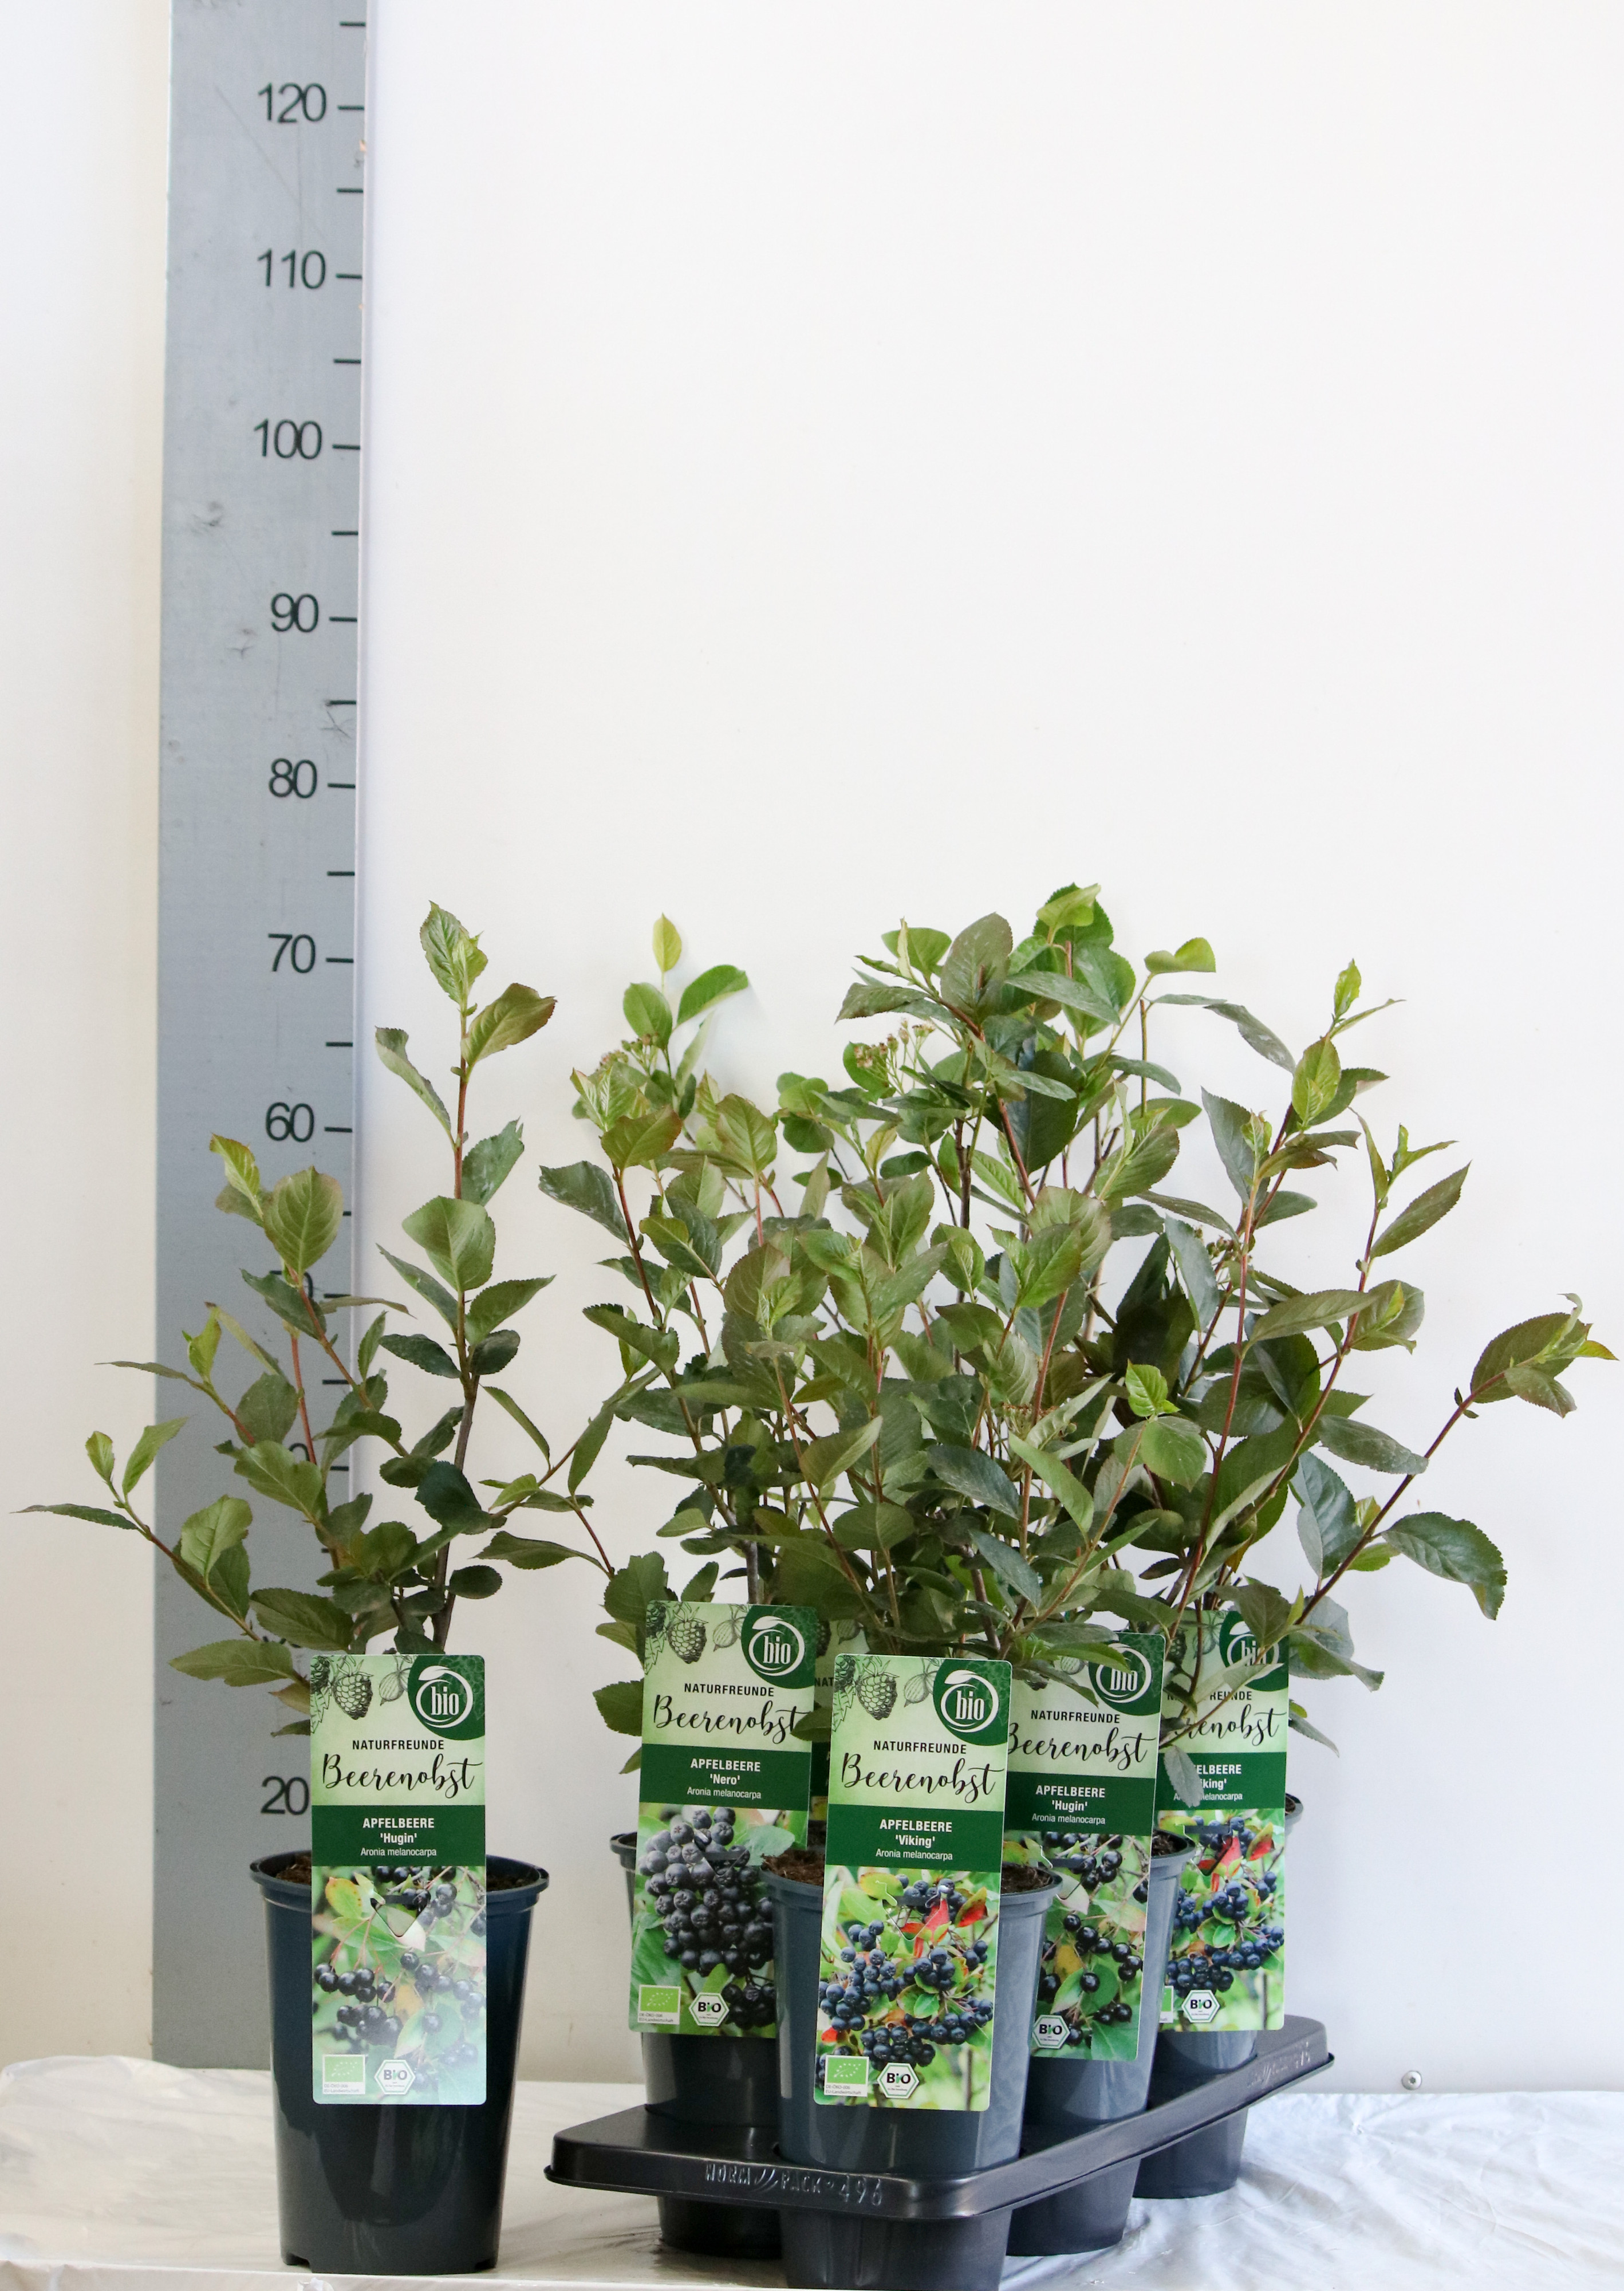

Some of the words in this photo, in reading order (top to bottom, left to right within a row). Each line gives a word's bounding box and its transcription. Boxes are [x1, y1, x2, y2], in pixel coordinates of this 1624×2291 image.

[258, 82, 327, 123] 120
[257, 249, 326, 289] 110
[254, 419, 322, 460] 100
[270, 593, 319, 633] 90
[269, 758, 317, 798] 80
[268, 934, 316, 973] 70
[265, 1102, 314, 1143] 60
[763, 1635, 791, 1665] bio
[684, 1683, 774, 1697] NATURFREUNDE
[431, 1687, 459, 1716] bio
[955, 1690, 986, 1721] bio
[653, 1694, 811, 1745] Beerenobst
[1031, 1710, 1120, 1724] NATURFREUNDE
[352, 1739, 444, 1750] NATURFREUNDE
[873, 1740, 967, 1754] NATURFREUNDE
[691, 1758, 761, 1772] APFELBEERE
[1196, 1764, 1242, 1774] ELBEERE
[322, 1753, 483, 1798] Beerenobst
[710, 1774, 740, 1786] 'Nero'
[842, 1752, 1004, 1804] Beerenobst
[260, 1776, 310, 1815] 20
[687, 1786, 711, 1797] Aronia
[713, 1788, 762, 1800] melanocarpa
[1035, 1785, 1105, 1798] APFELBEERE
[1051, 1800, 1088, 1813] 'Hugin'
[362, 1818, 435, 1829] APFELBEERE
[879, 1818, 952, 1833] APFELBEERE
[1032, 1813, 1056, 1822] Aronia
[1058, 1814, 1106, 1825] melanocarpa
[380, 1832, 417, 1845] 'Hugin'
[895, 1835, 936, 1848] 'Viking'
[361, 1847, 385, 1856] Aronia
[387, 1847, 437, 1857] melanocarpa
[876, 1848, 901, 1858] Aronia
[902, 1850, 953, 1861] melanocarpa
